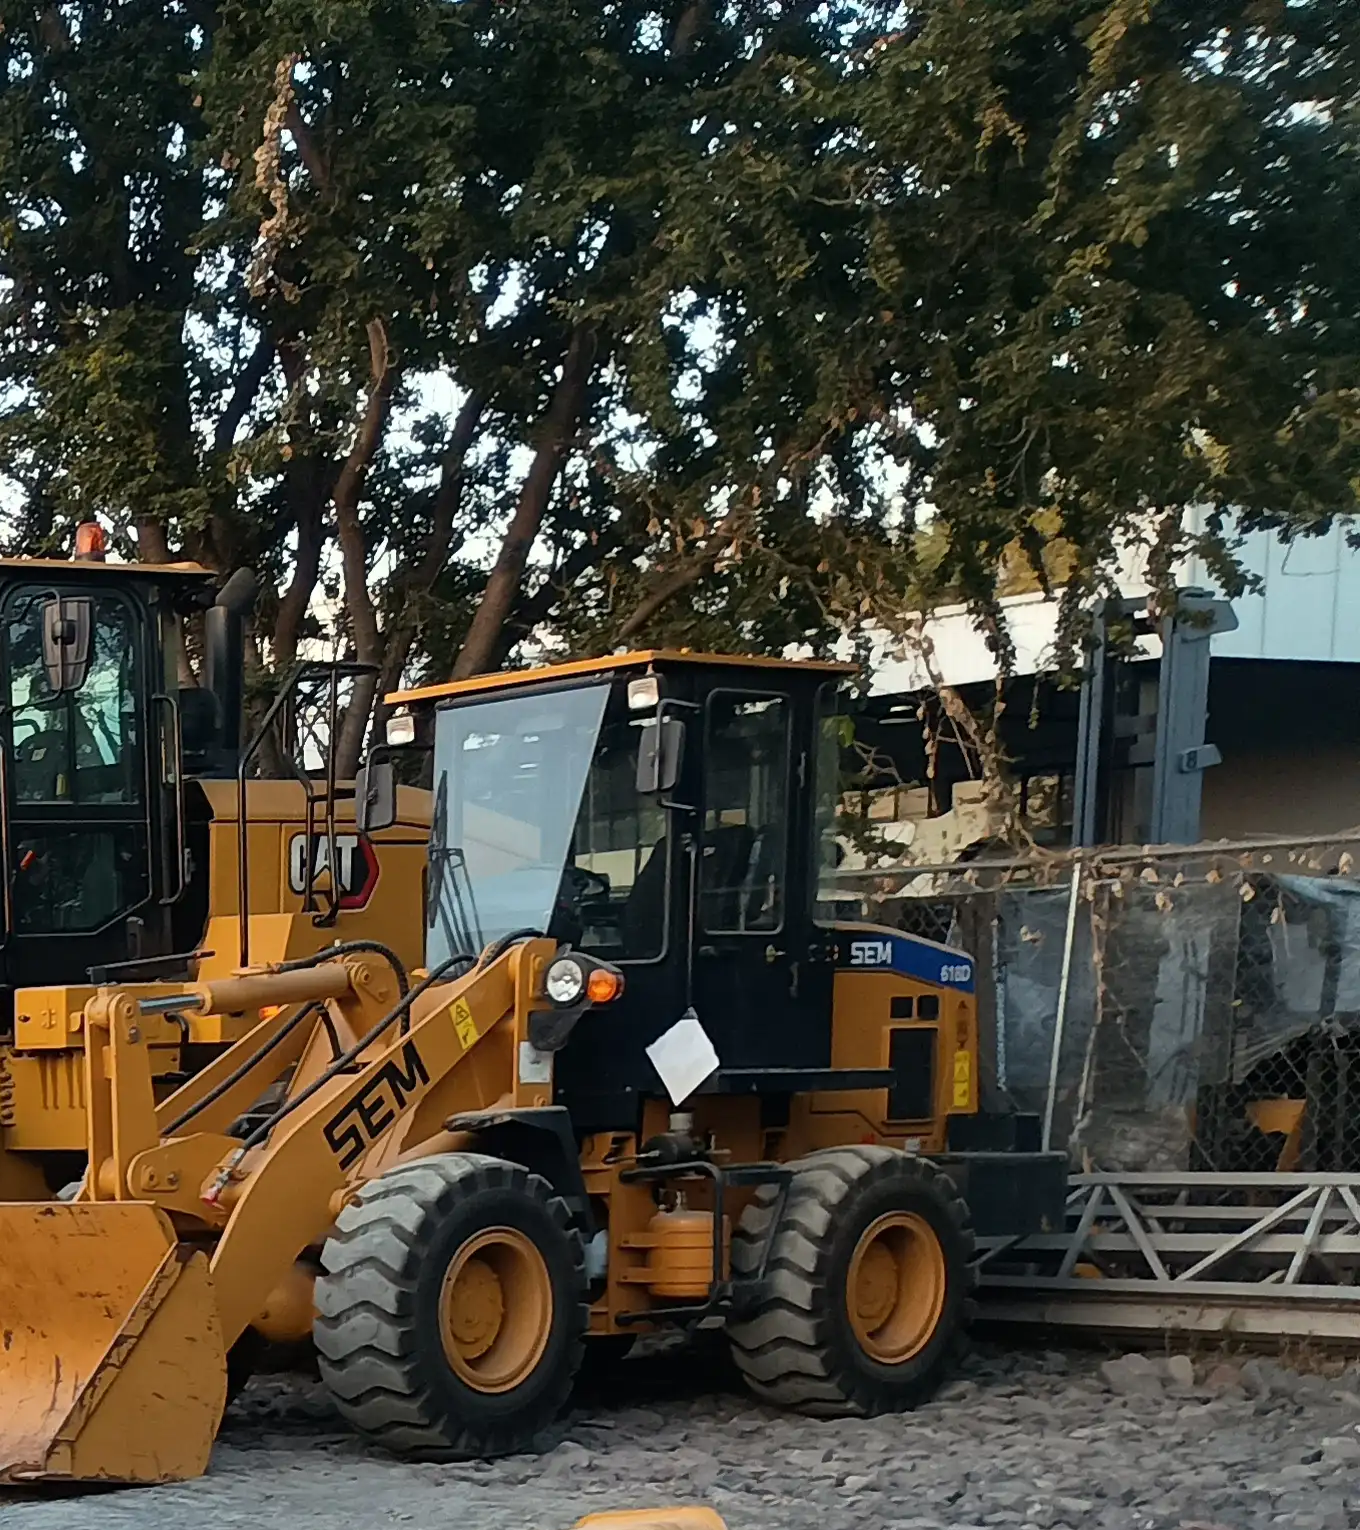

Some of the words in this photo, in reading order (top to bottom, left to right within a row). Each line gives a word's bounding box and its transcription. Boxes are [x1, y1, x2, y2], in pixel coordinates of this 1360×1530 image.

[290, 834, 358, 892] CAT
[850, 941, 892, 964] SEM
[323, 1039, 430, 1172] SEM
